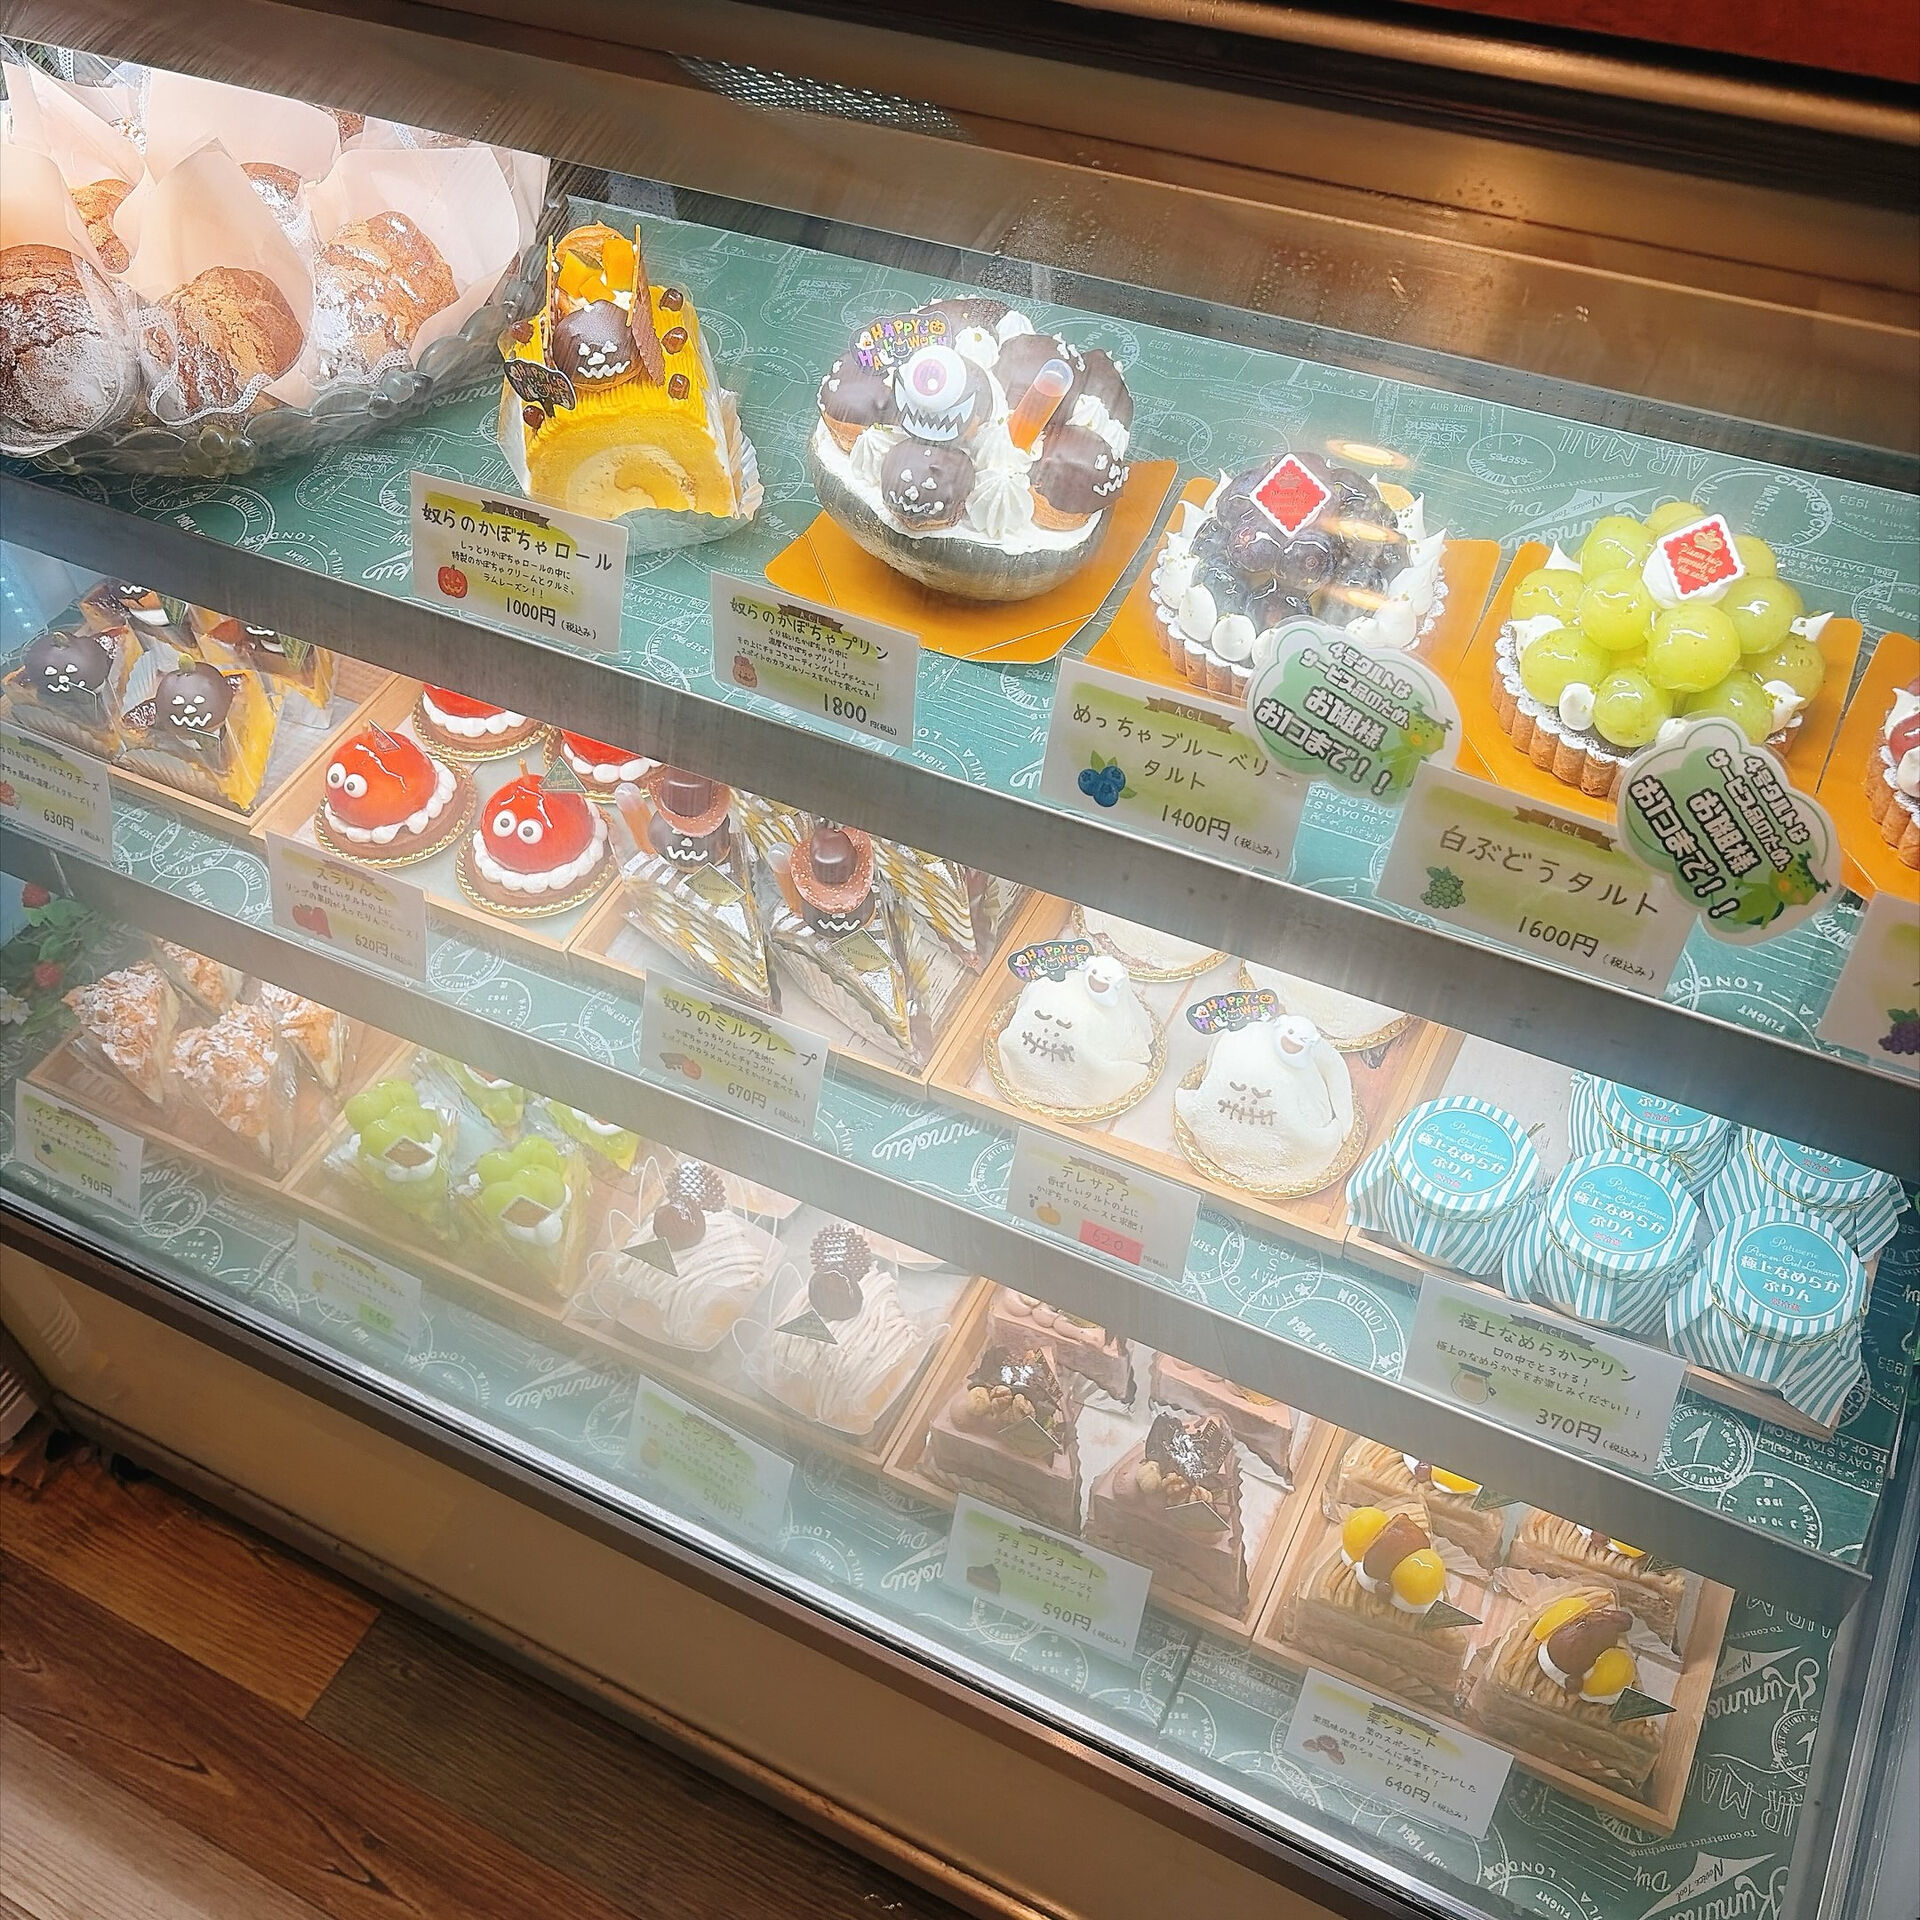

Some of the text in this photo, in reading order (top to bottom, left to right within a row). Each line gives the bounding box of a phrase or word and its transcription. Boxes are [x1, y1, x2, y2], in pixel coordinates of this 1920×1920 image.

[870, 319, 921, 342] HAPPY
[1557, 425, 1710, 481] AIR MAIL
[1502, 481, 1566, 497] something
[1567, 473, 1626, 490] construct
[228, 493, 264, 523] LONDON
[1502, 500, 1544, 517] Diy
[422, 503, 613, 571] 奴らのかぼちゃロール
[285, 548, 312, 567] FLIGHT
[451, 550, 575, 595] 特製のかぼちゃクリームとクルミ、
[460, 540, 571, 580] しっとりかぼちゃロールの中に
[1799, 560, 1833, 575] DAYS
[1810, 553, 1829, 562] OF
[1832, 558, 1866, 573] DATE
[506, 597, 556, 627] 1000円
[656, 592, 684, 605] DATE
[729, 597, 889, 660] 奴らのかぼちゃプリン
[1329, 641, 1412, 700] 4号タルトは
[1300, 648, 1409, 729] サービス品のため、
[824, 693, 867, 724] 1800
[1072, 703, 1294, 780] めっちゃブルーベリー
[912, 749, 948, 772] FLIGHT
[1144, 759, 1206, 790] タルト
[1325, 804, 1360, 820] DAYS
[1707, 748, 1793, 872] サービス品のため、
[1744, 756, 1810, 845] 4号タルトは
[44, 809, 74, 831] 630円
[1161, 804, 1231, 841] 1400円
[233, 859, 262, 891] LONDON
[316, 867, 389, 901] スラりんご
[1440, 824, 1658, 916] 白ぶどうタルト
[355, 934, 389, 957] 620円
[1518, 916, 1600, 958] 1600円
[1025, 945, 1067, 961] HAPPY
[1206, 994, 1251, 1011] HAPPY
[662, 994, 818, 1066] 奴らのミルクレープ
[1737, 1004, 1785, 1033] FLIGHT
[727, 1082, 767, 1109] 670円
[890, 1097, 924, 1117] Diy
[1416, 1133, 1506, 1176] 極上なめらか
[1061, 1165, 1129, 1201] テレサ？？
[1573, 1191, 1665, 1234] 極上なめらか
[1092, 1229, 1124, 1251] 620
[1740, 1254, 1841, 1294] 極上なめらか
[1336, 1288, 1387, 1333] LONDON
[1458, 1312, 1636, 1383] 極上なめらかプリン
[1436, 1339, 1642, 1420] 極上のなめらかさをお楽しみください！！
[1492, 1347, 1589, 1388] 口の中でとろける！
[1534, 1407, 1602, 1445] 370円
[1803, 1438, 1835, 1458] STAY
[1838, 1450, 1871, 1470] DAYS
[1852, 1446, 1869, 1457] OF
[897, 1528, 928, 1549] Diy
[997, 1533, 1099, 1580] チョコショート
[1042, 1602, 1092, 1632] 590円
[1366, 1710, 1436, 1748] 栗ショート
[1384, 1776, 1430, 1804] 640円
[1629, 1828, 1757, 1858] To construct something
[1633, 1866, 1671, 1893] Diy
[1695, 1859, 1725, 1893] Novice
[1535, 1891, 1571, 1919] FLIGHT
[1674, 1884, 1695, 1901] Tool
